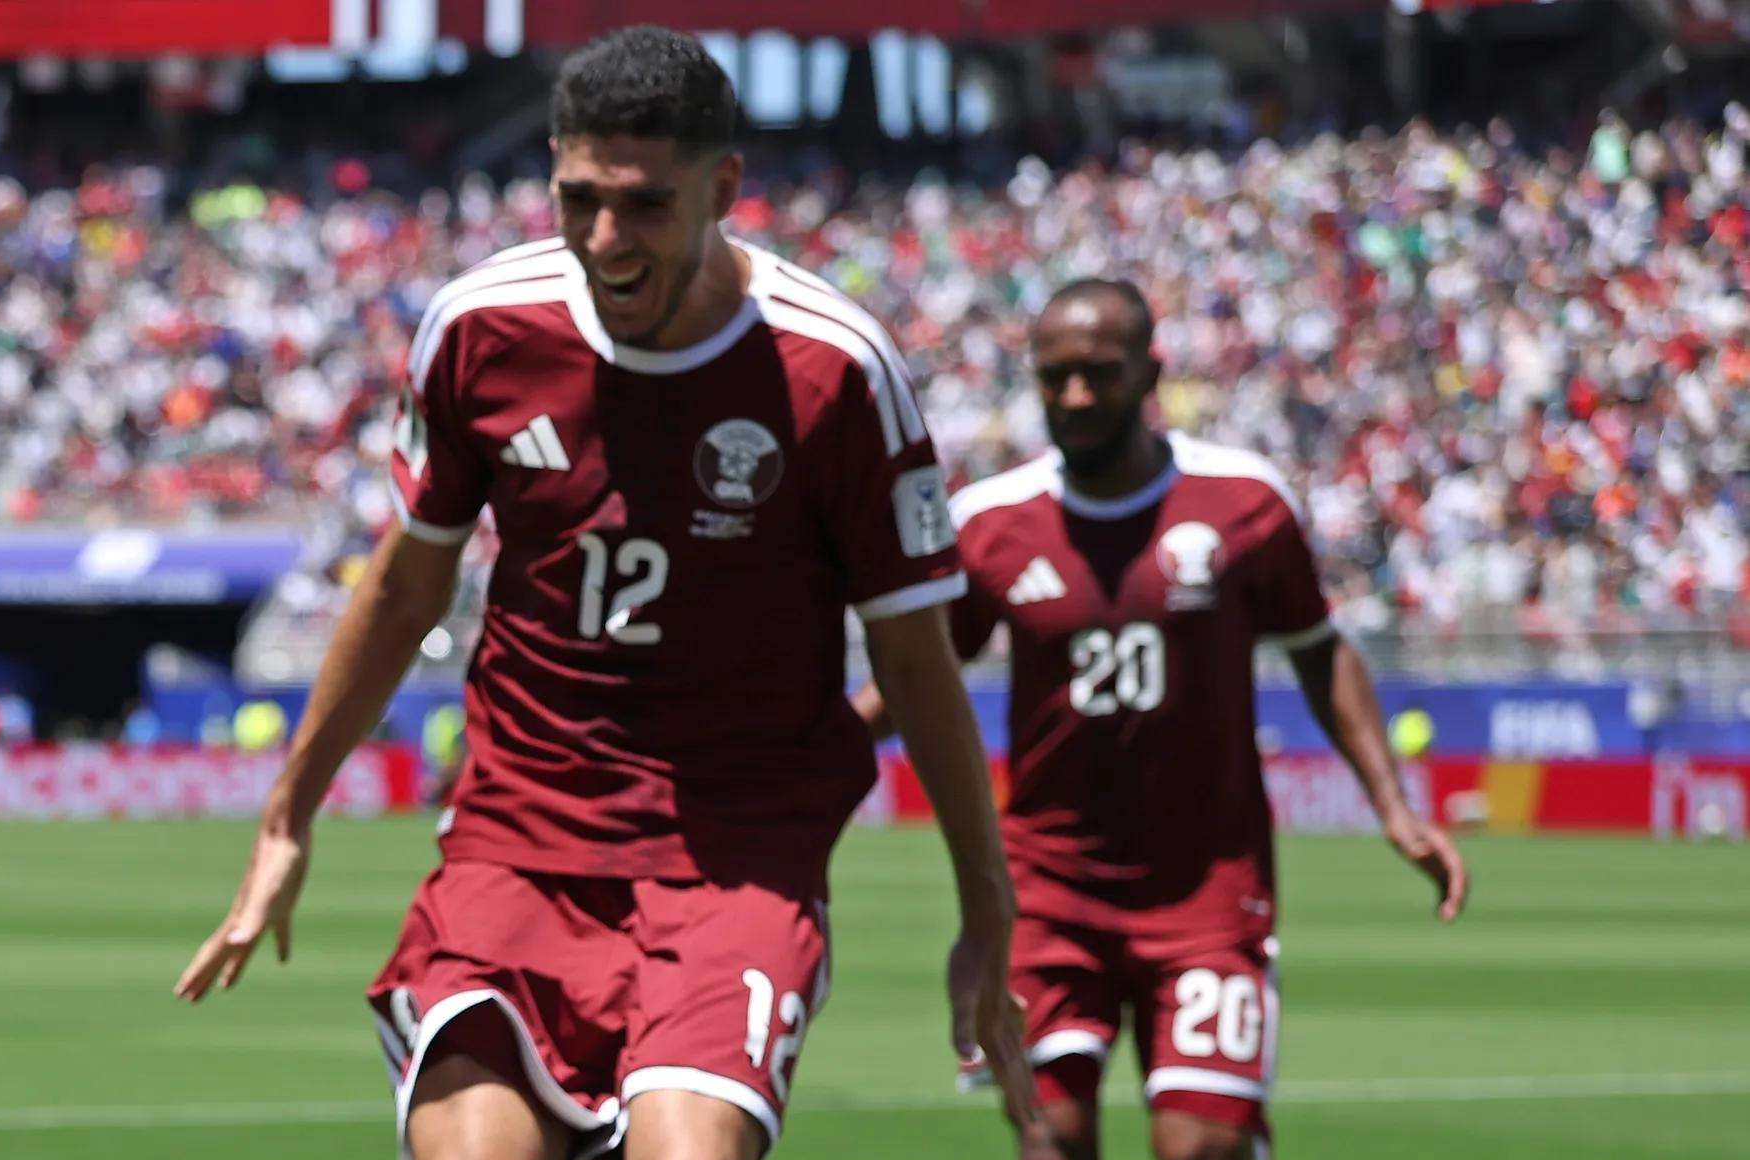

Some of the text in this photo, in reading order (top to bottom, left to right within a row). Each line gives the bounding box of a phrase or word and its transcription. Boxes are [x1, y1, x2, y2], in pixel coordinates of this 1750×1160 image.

[576, 531, 669, 645] 12
[1068, 621, 1166, 717] 20
[742, 968, 806, 1103] 12
[1172, 968, 1262, 1062] 20
